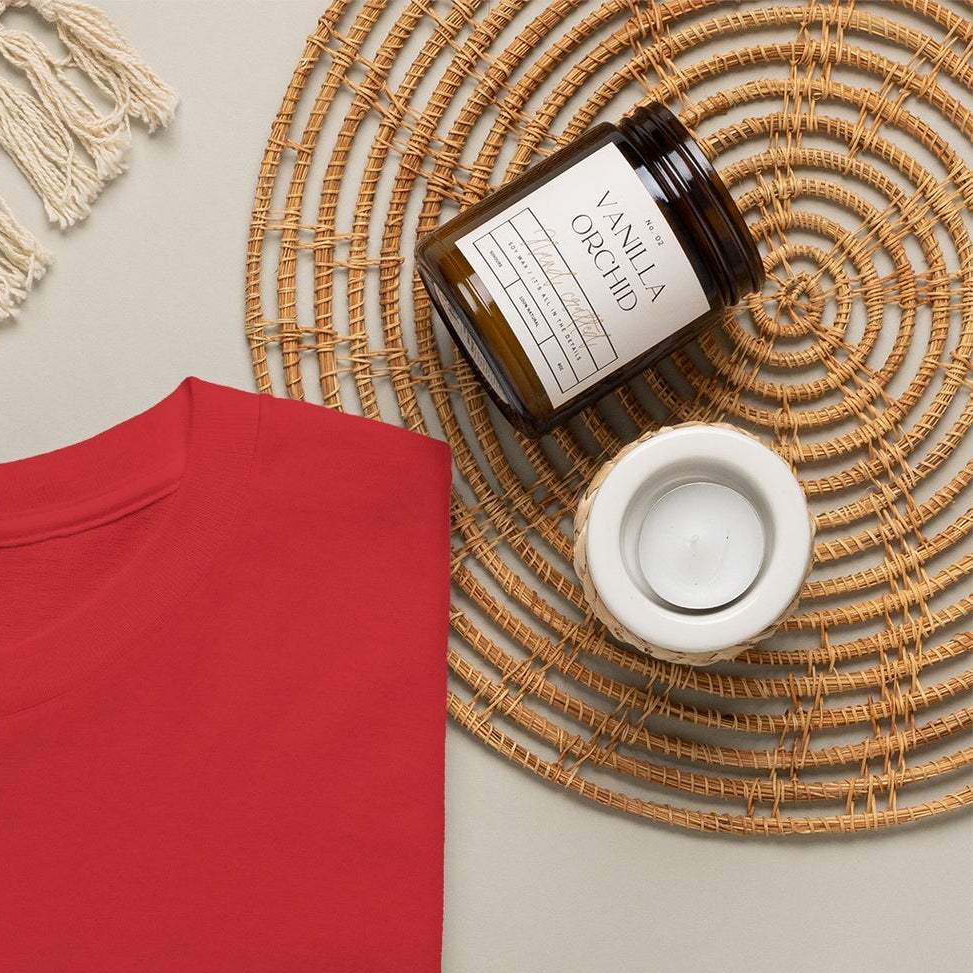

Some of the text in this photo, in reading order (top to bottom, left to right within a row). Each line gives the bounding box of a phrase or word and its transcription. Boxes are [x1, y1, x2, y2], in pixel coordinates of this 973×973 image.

[570, 213, 638, 311] ORCHID
[596, 189, 666, 303] VANILLA
[644, 218, 664, 246] No. 02
[507, 240, 518, 254] SOY
[516, 254, 528, 269] WAX
[541, 292, 551, 306] ALL
[549, 307, 557, 317] IN
[555, 317, 567, 332] THE
[564, 333, 582, 361] DETAILS
[526, 307, 539, 328] NATURAL
